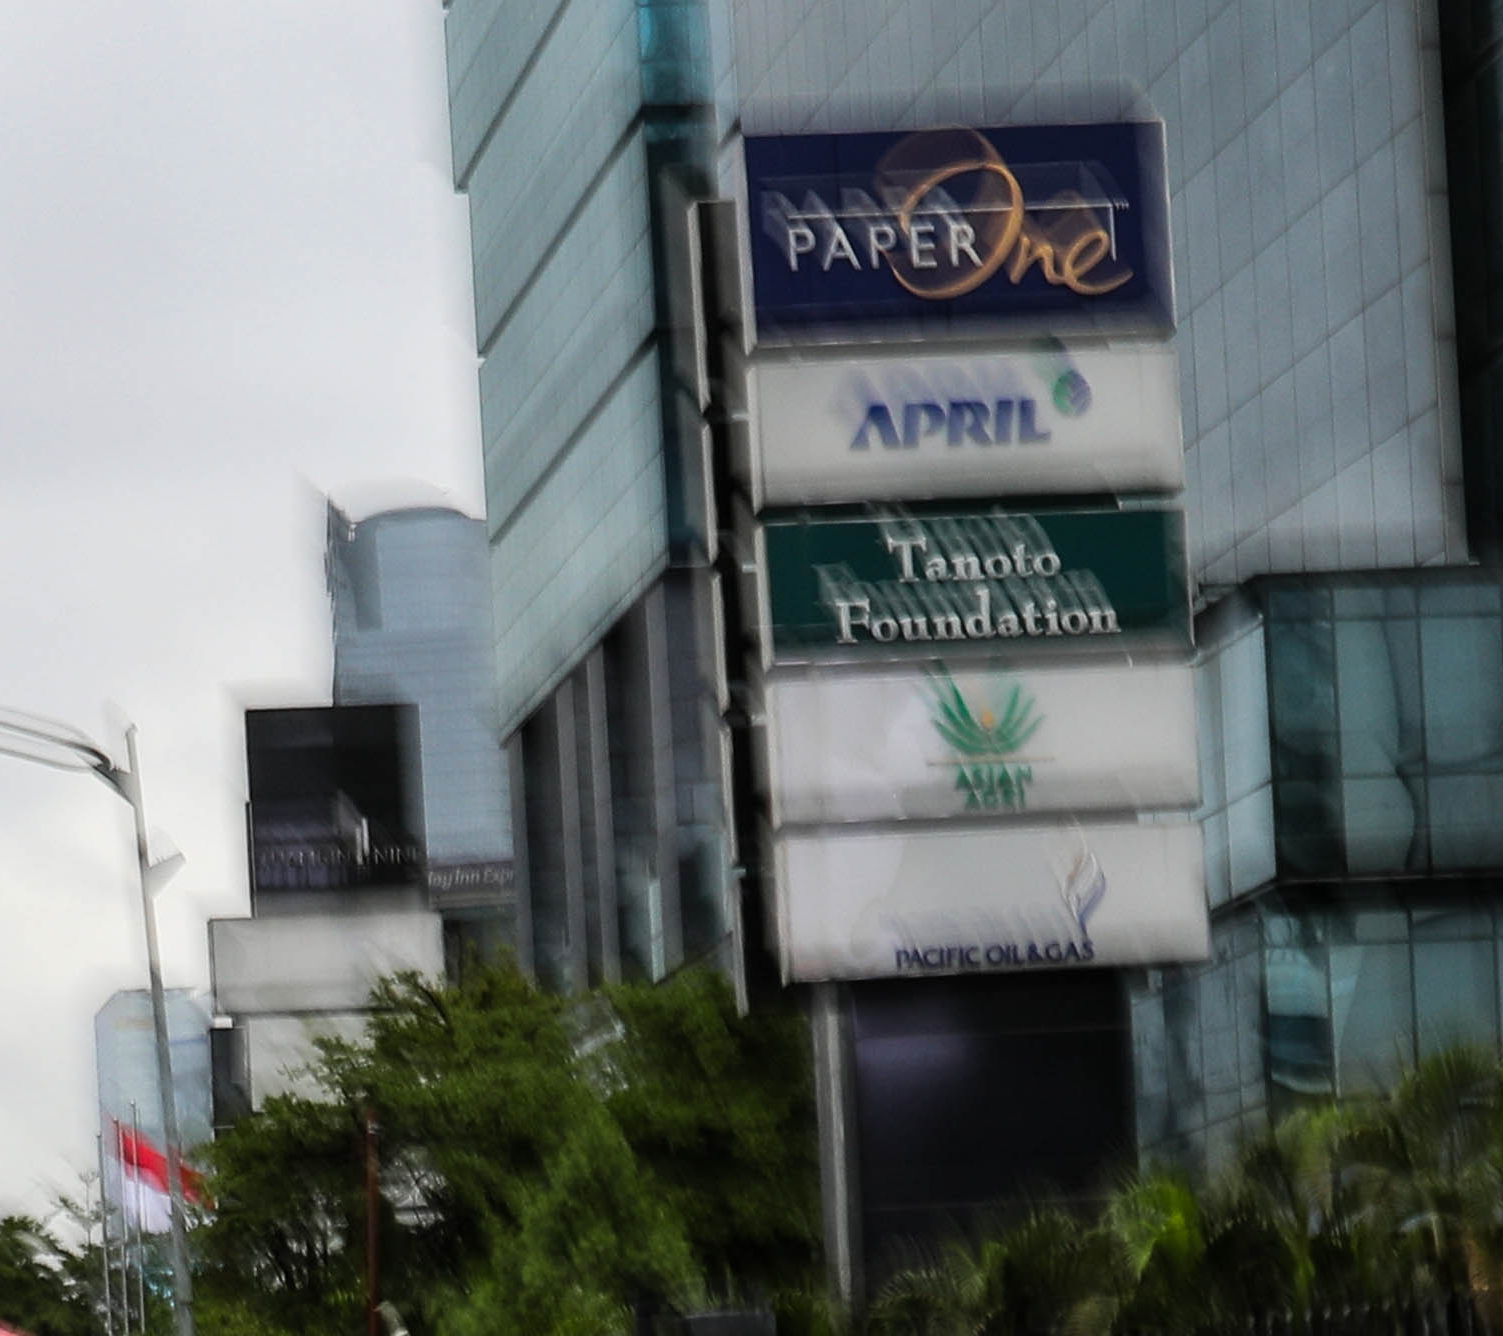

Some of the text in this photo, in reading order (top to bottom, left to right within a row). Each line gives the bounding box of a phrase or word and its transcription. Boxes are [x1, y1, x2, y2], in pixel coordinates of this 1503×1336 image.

[787, 221, 984, 272] PAPER
[849, 397, 1052, 451] APRIL
[887, 534, 1062, 583] Tanoto
[834, 586, 1122, 645] Foundation
[955, 763, 1034, 790] ASIAN
[895, 944, 981, 968] PACIFIC
